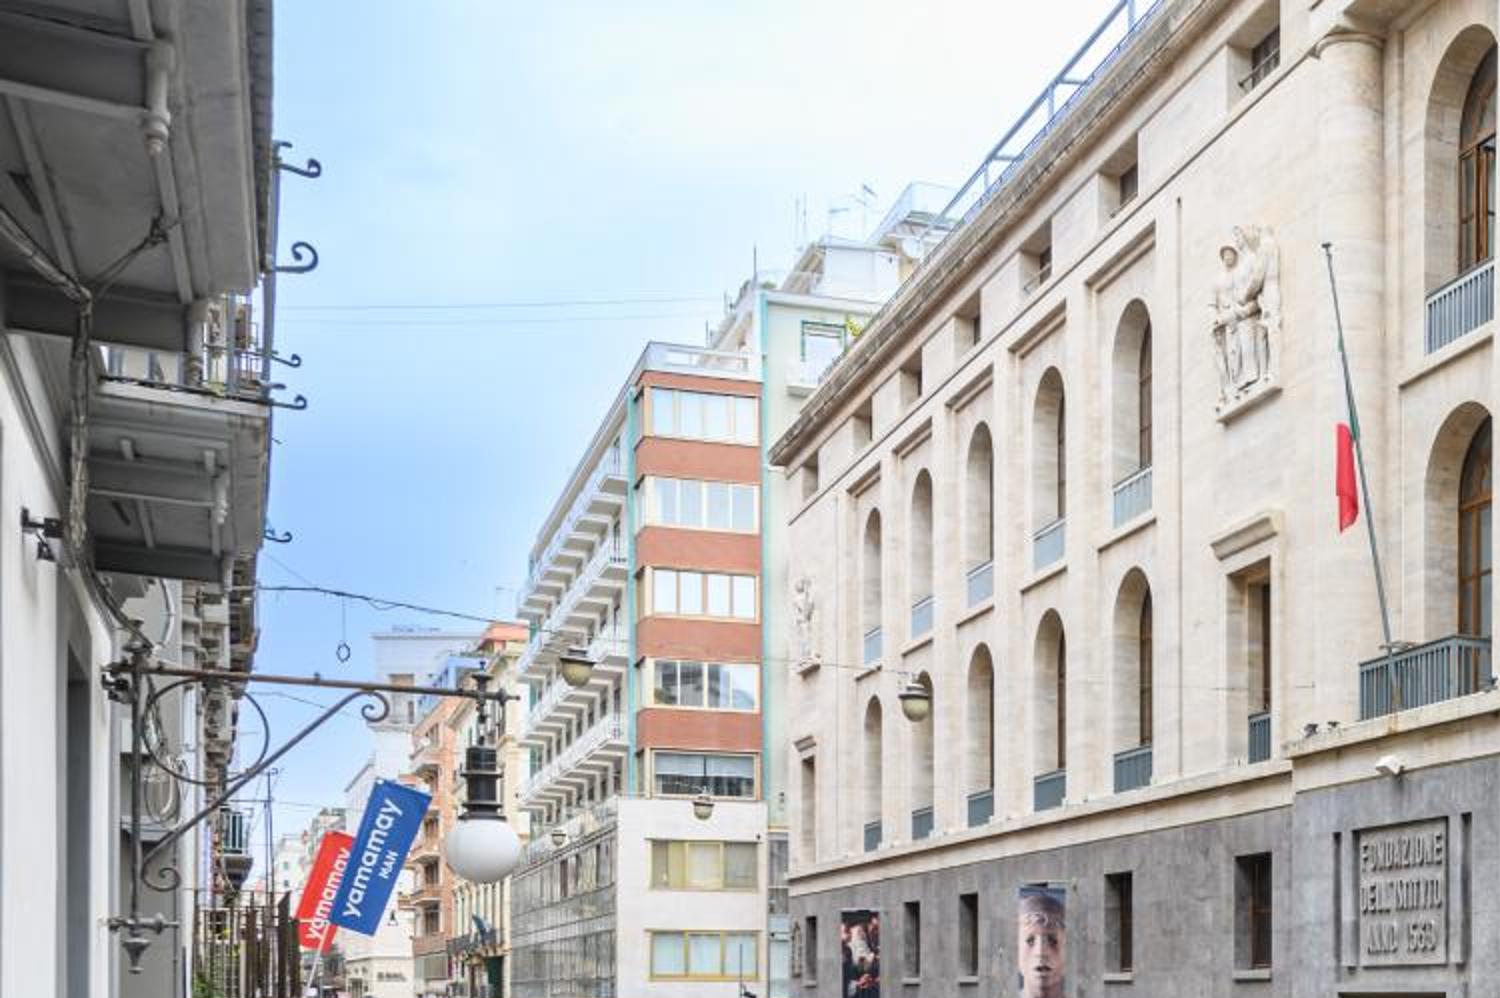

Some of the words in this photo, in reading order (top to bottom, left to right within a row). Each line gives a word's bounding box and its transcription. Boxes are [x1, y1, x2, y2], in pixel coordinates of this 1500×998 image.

[342, 797, 403, 918] yamamay
[378, 850, 400, 880] MAN
[1361, 832, 1442, 871] FONDAZIONE
[1367, 920, 1399, 955] ANNO
